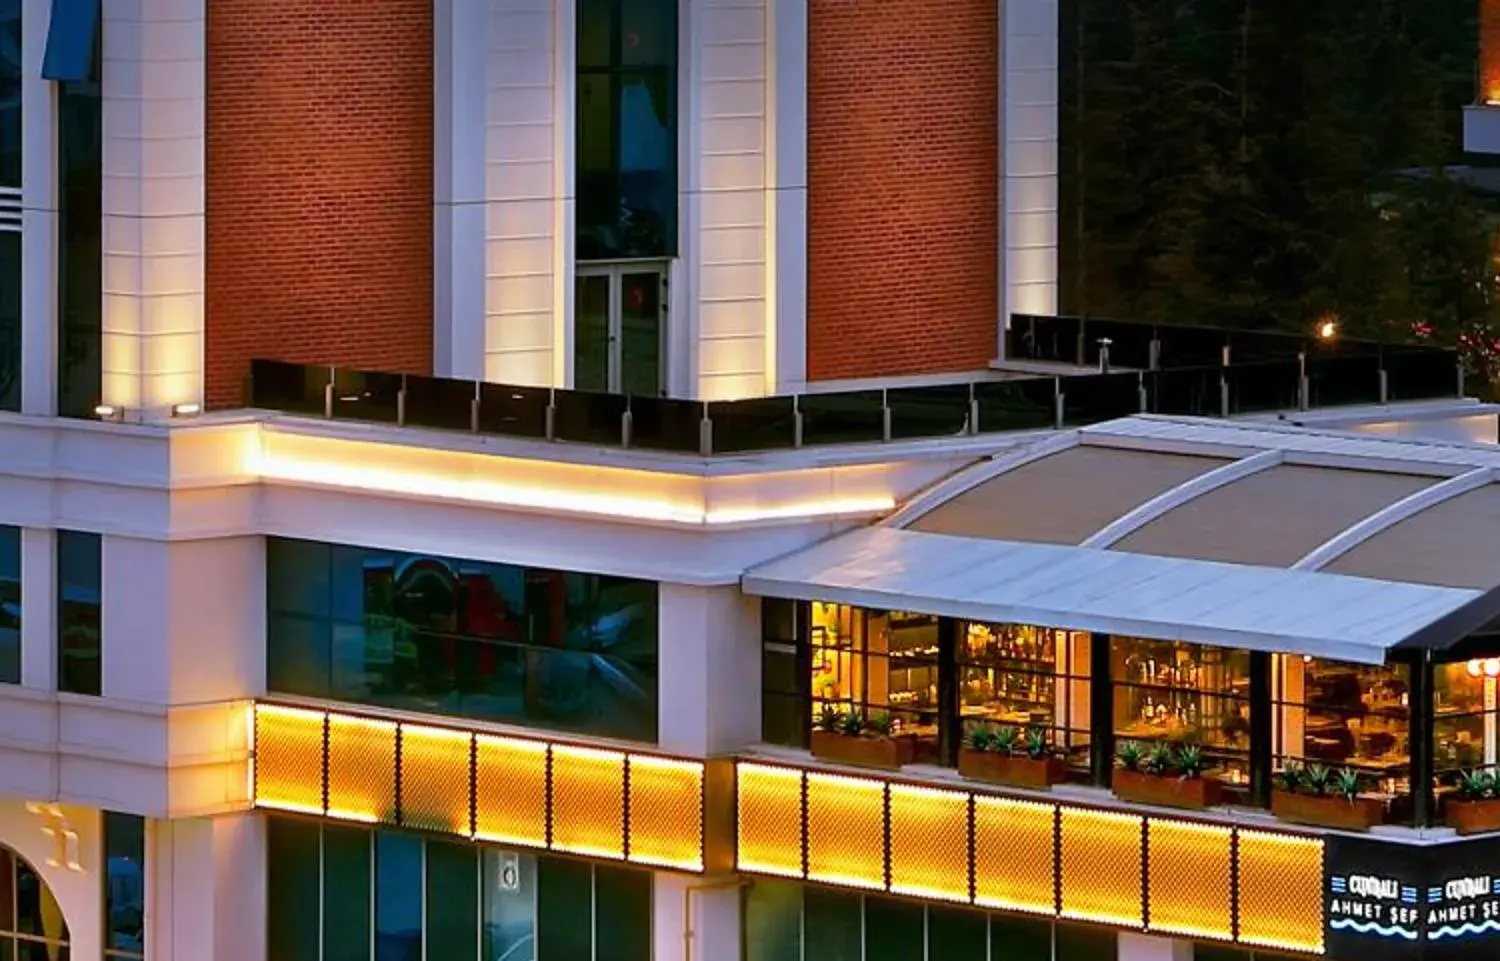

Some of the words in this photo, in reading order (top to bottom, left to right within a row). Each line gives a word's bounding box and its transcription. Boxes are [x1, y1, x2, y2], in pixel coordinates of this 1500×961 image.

[1330, 899, 1382, 919] AHMET
[1389, 906, 1419, 925] ŞEF
[1427, 905, 1476, 924] AHMET
